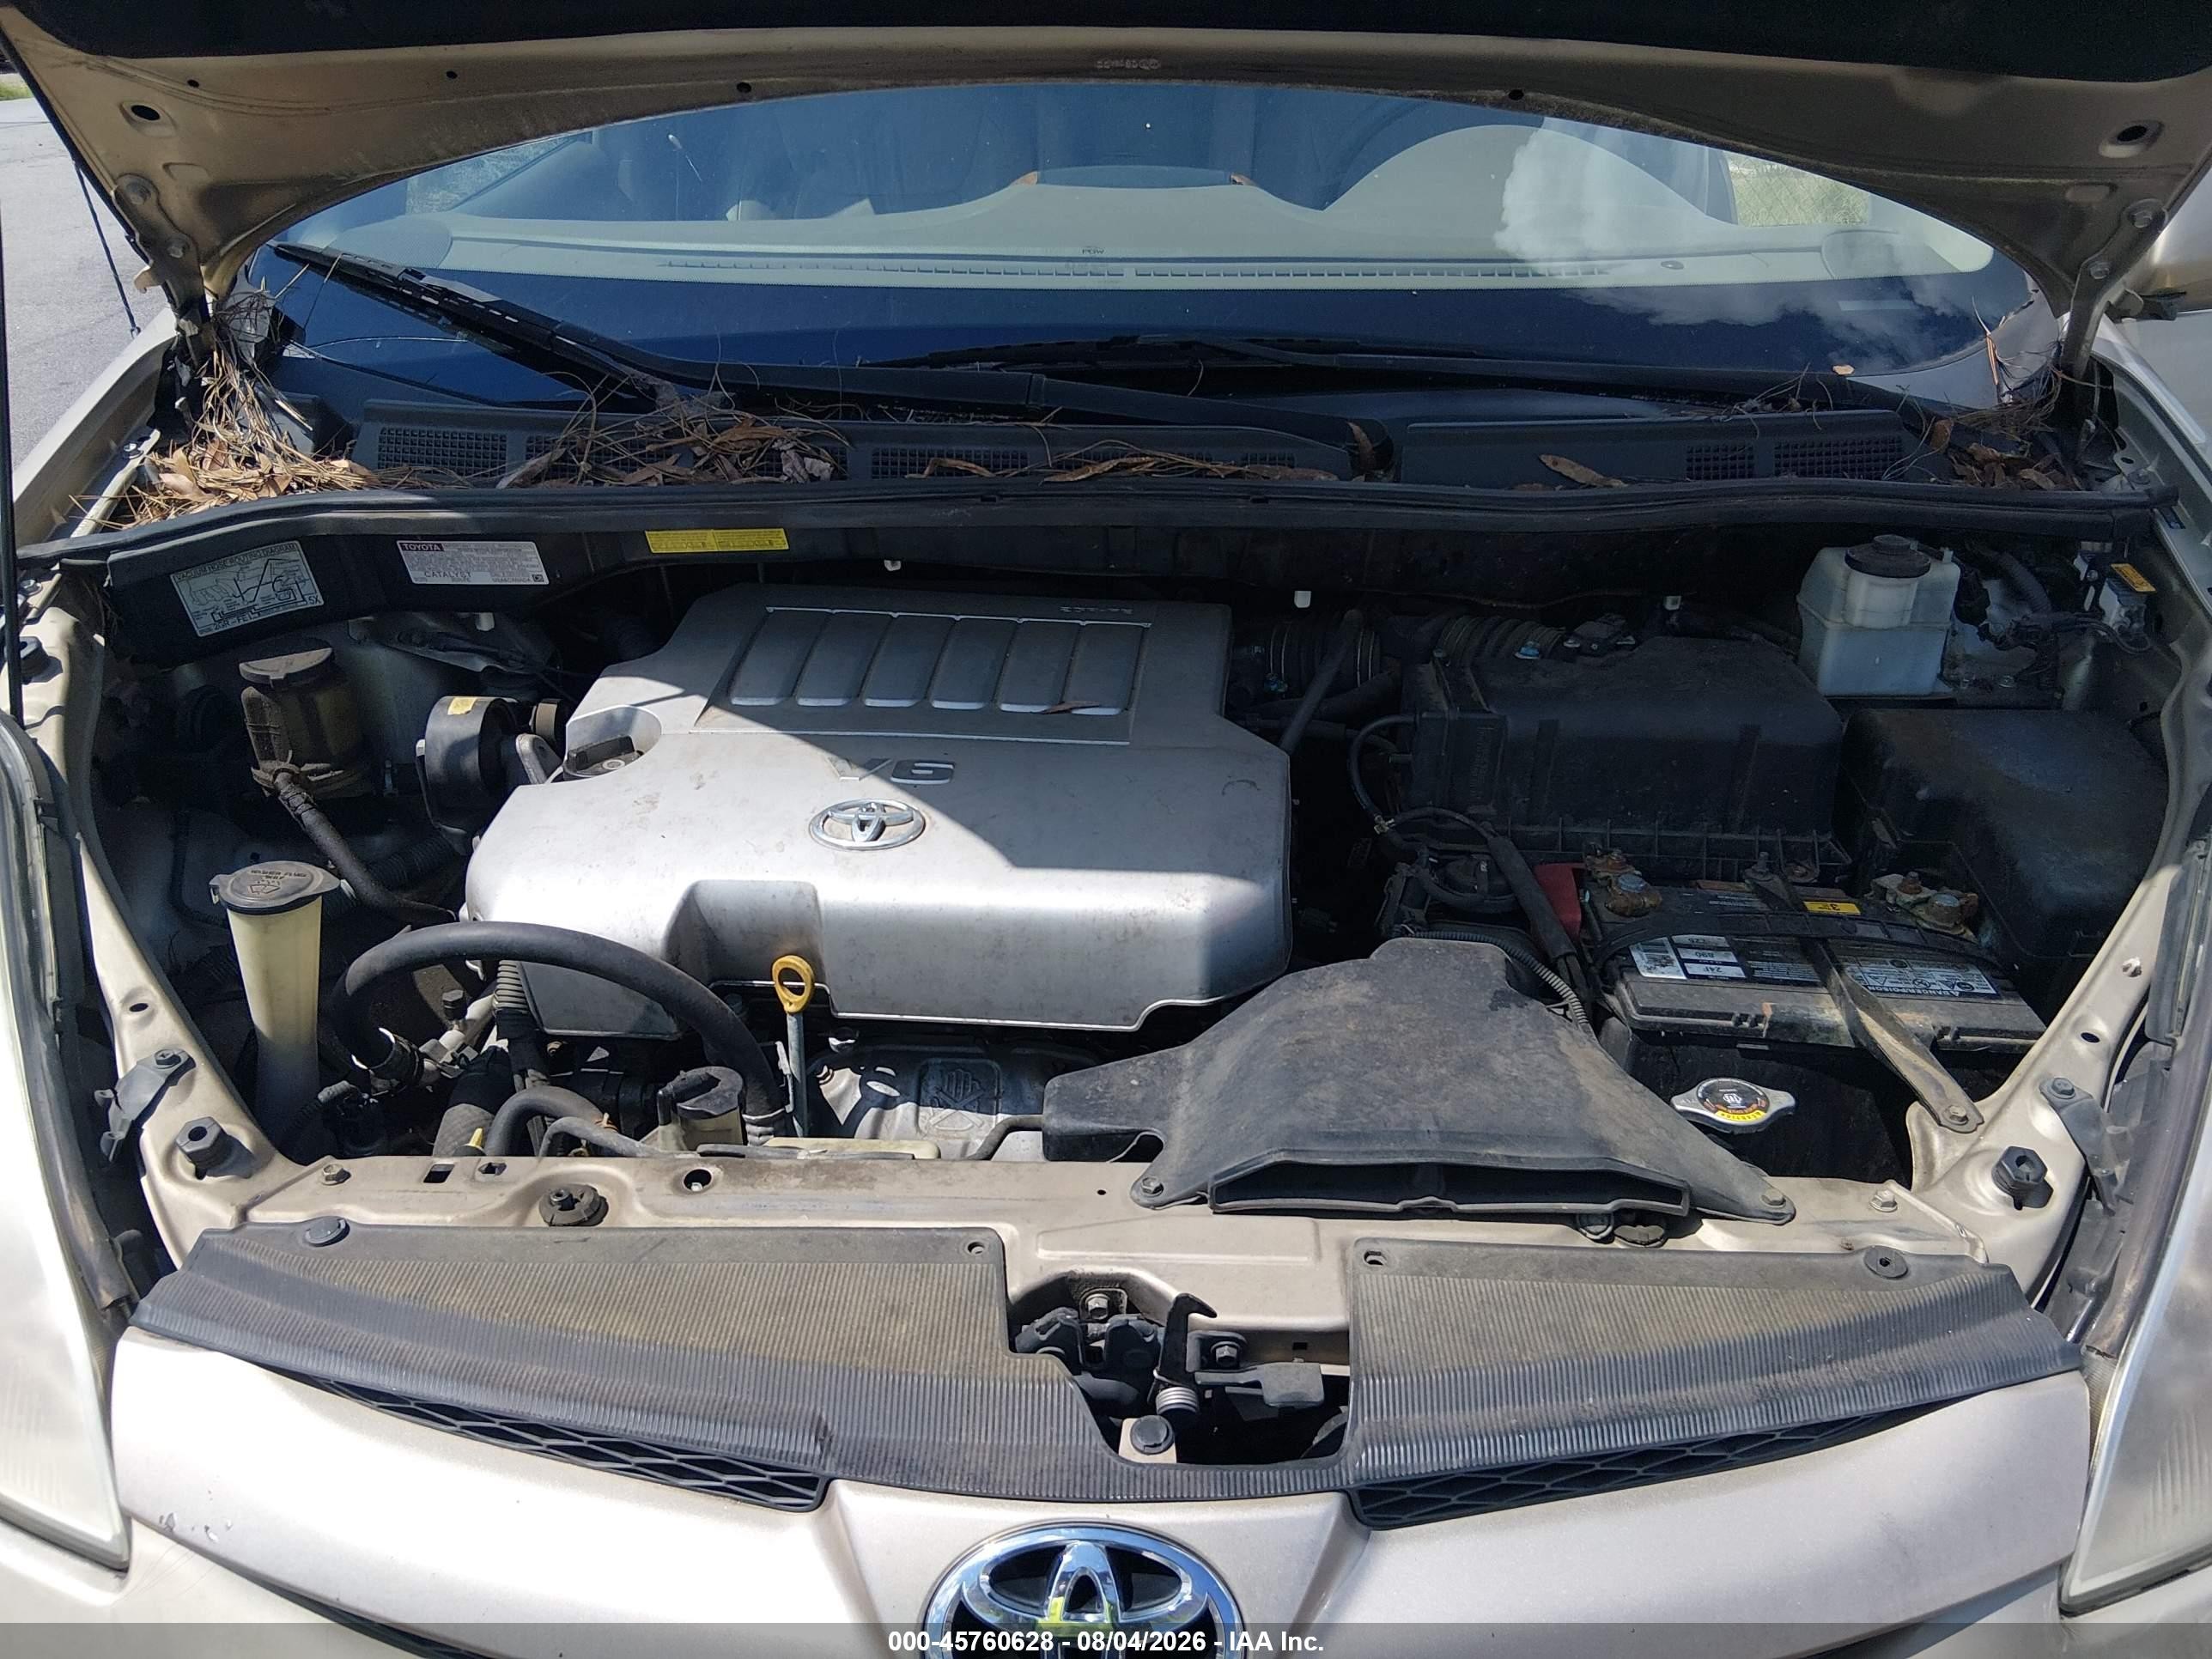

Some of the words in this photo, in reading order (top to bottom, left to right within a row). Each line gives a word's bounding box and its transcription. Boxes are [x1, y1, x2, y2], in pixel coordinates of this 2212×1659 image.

[264, 544, 296, 557] DIAGRAM
[404, 543, 441, 551] TOYOTA
[826, 757, 956, 785] V6
